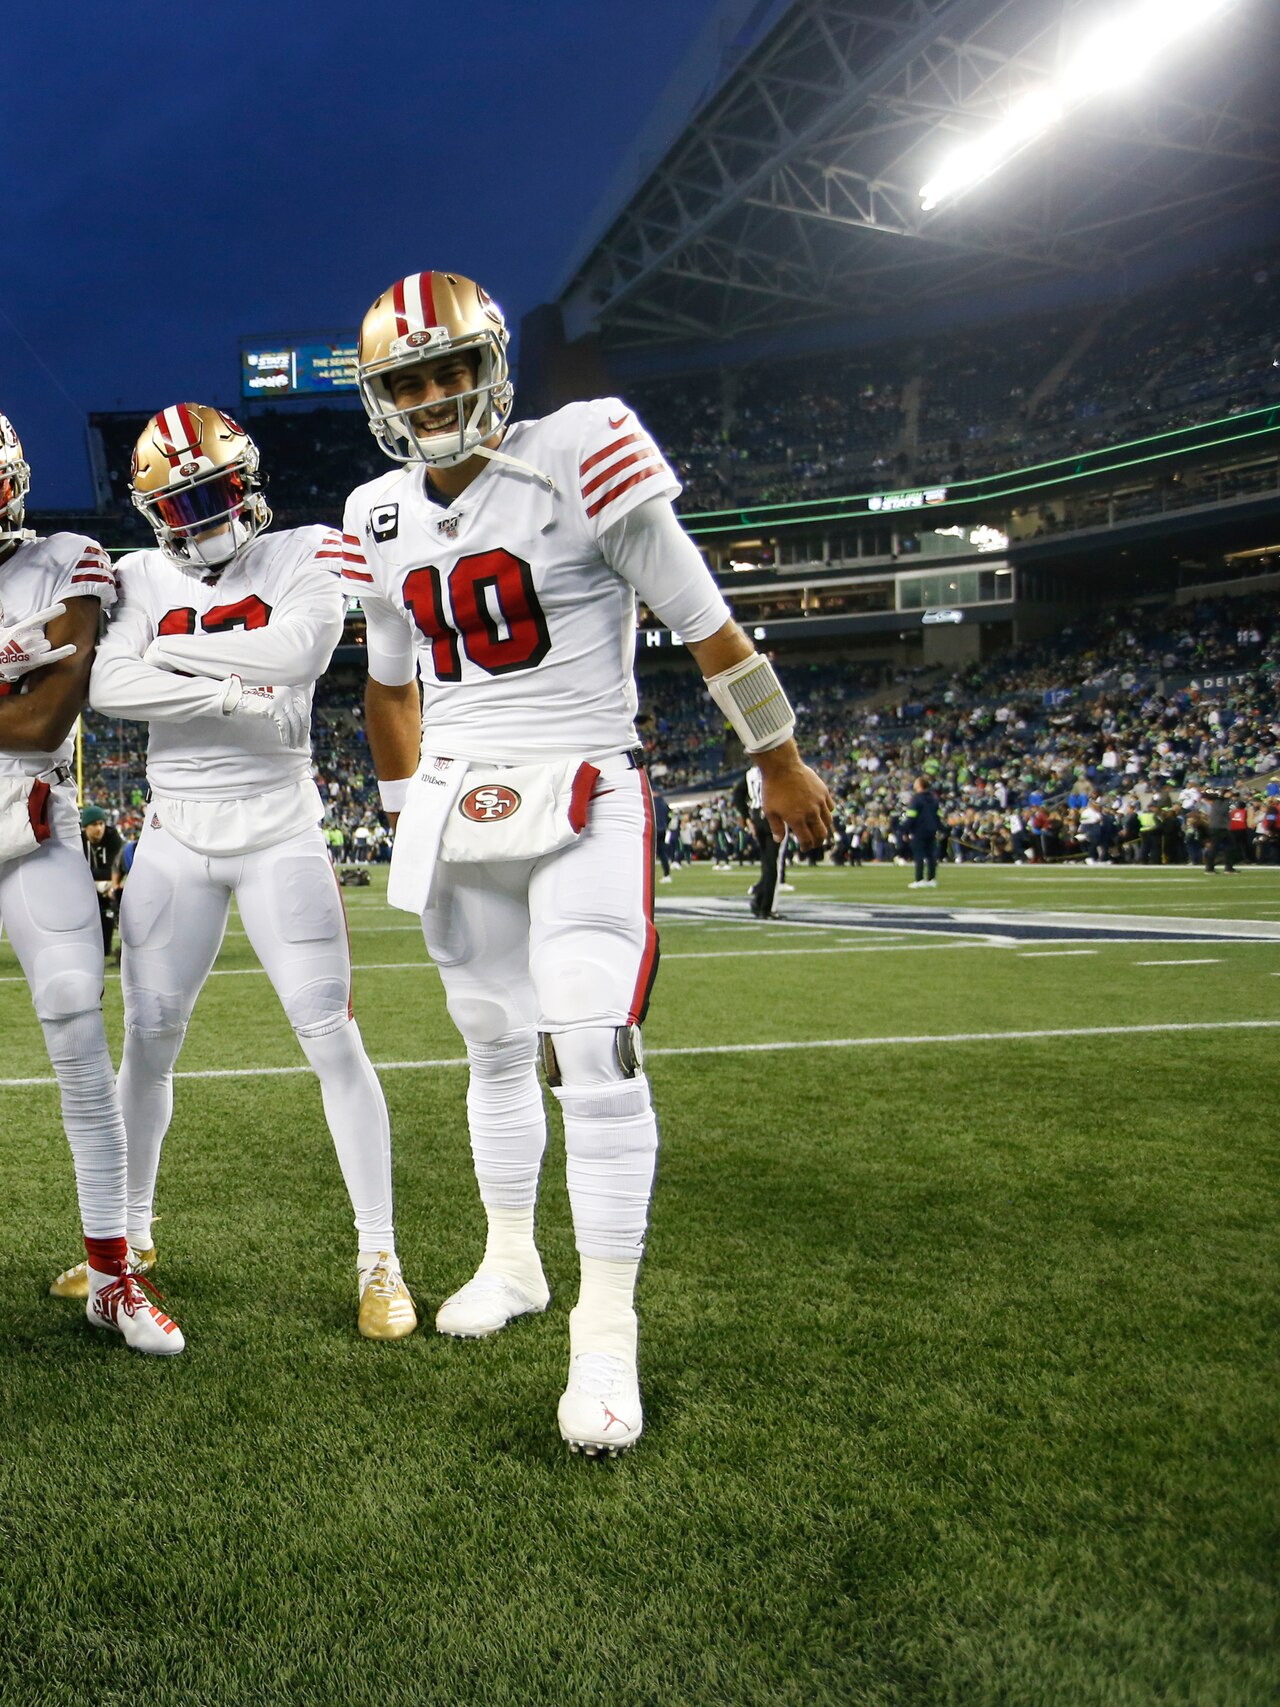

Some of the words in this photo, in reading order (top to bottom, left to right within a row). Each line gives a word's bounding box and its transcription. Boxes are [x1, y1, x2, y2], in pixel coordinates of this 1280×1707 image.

[371, 506, 397, 532] C
[402, 547, 552, 682] 10
[242, 688, 274, 700] adidas
